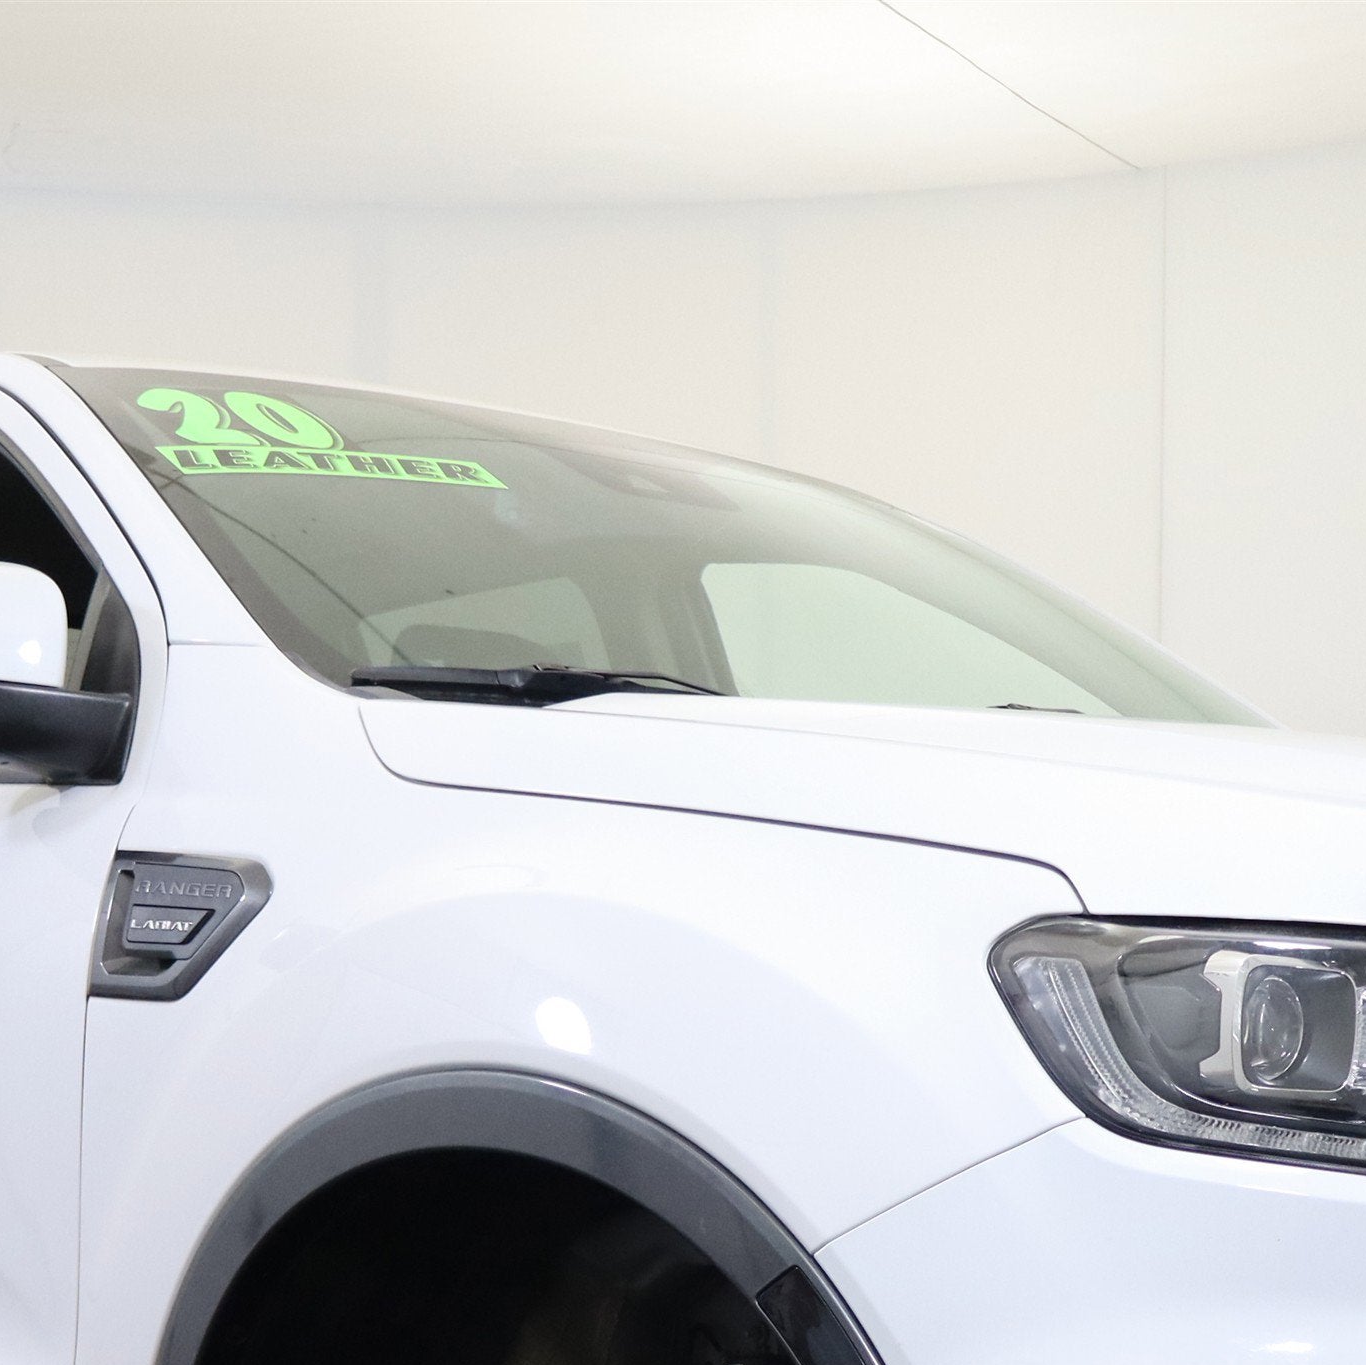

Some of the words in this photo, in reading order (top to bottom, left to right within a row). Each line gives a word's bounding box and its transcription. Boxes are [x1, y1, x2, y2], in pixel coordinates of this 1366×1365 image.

[137, 387, 345, 451] 20
[171, 448, 490, 483] LEATHER
[136, 879, 233, 899] RANGER
[130, 918, 195, 931] LARIAT
